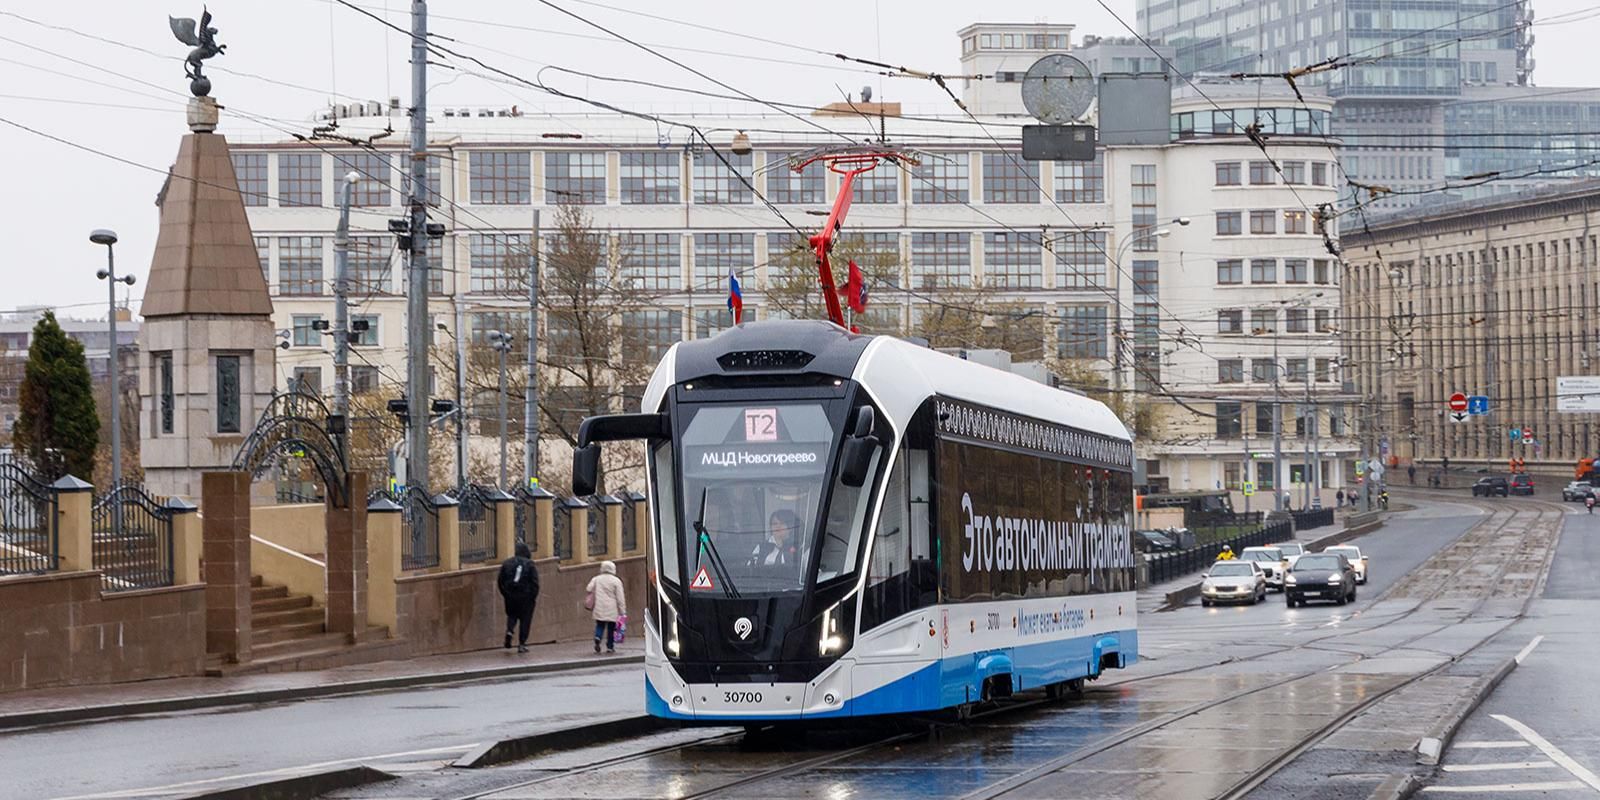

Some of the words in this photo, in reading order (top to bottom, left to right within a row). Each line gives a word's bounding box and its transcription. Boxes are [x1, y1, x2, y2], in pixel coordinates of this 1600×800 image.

[747, 414, 774, 435] Т2
[702, 452, 736, 467] МЦД
[738, 451, 817, 466] Новогиреево
[961, 492, 994, 573] Это
[995, 505, 1083, 572] автономный
[1018, 608, 1038, 636] Может
[724, 692, 763, 703] 30700
